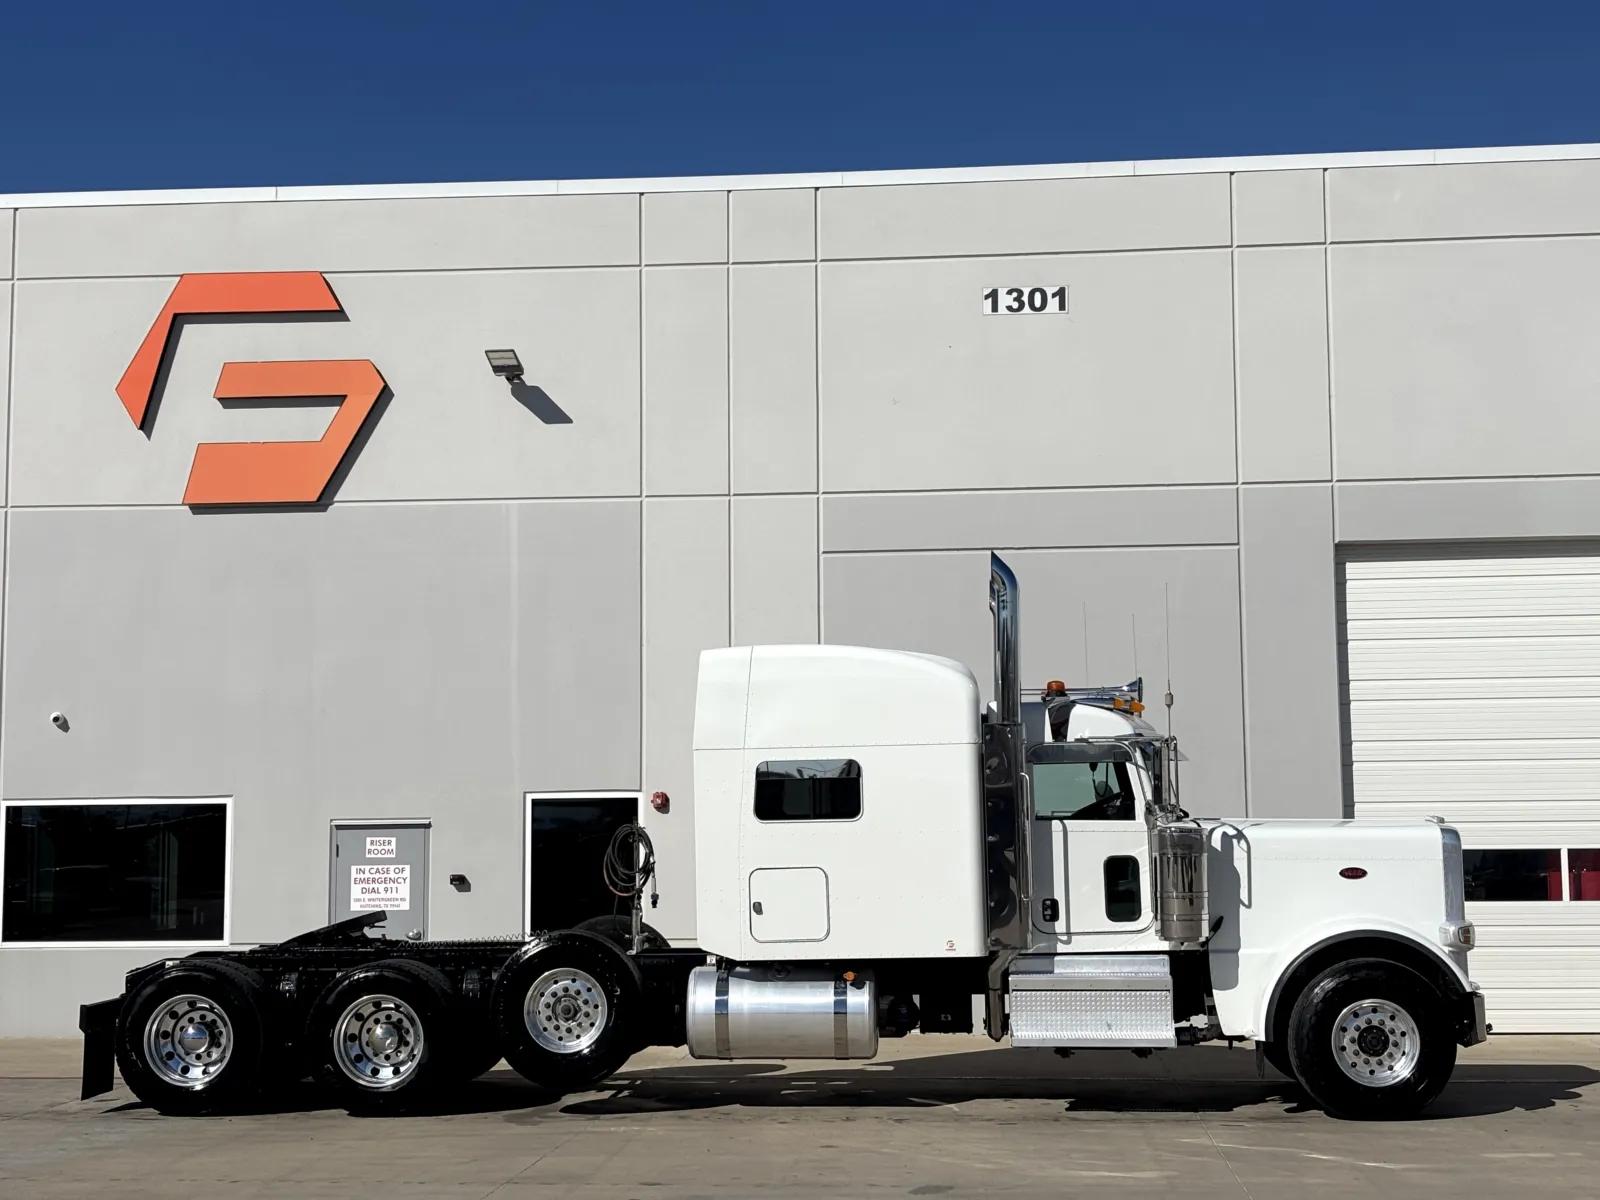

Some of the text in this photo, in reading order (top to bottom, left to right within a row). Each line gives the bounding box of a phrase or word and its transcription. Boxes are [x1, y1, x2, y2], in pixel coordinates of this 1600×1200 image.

[984, 286, 1066, 313] 1301
[370, 839, 392, 847] RISER
[367, 848, 394, 856] ROOM
[355, 867, 406, 875] IN CASE OF
[353, 876, 408, 885] EMERGENCY
[361, 886, 399, 895] DIAL 911
